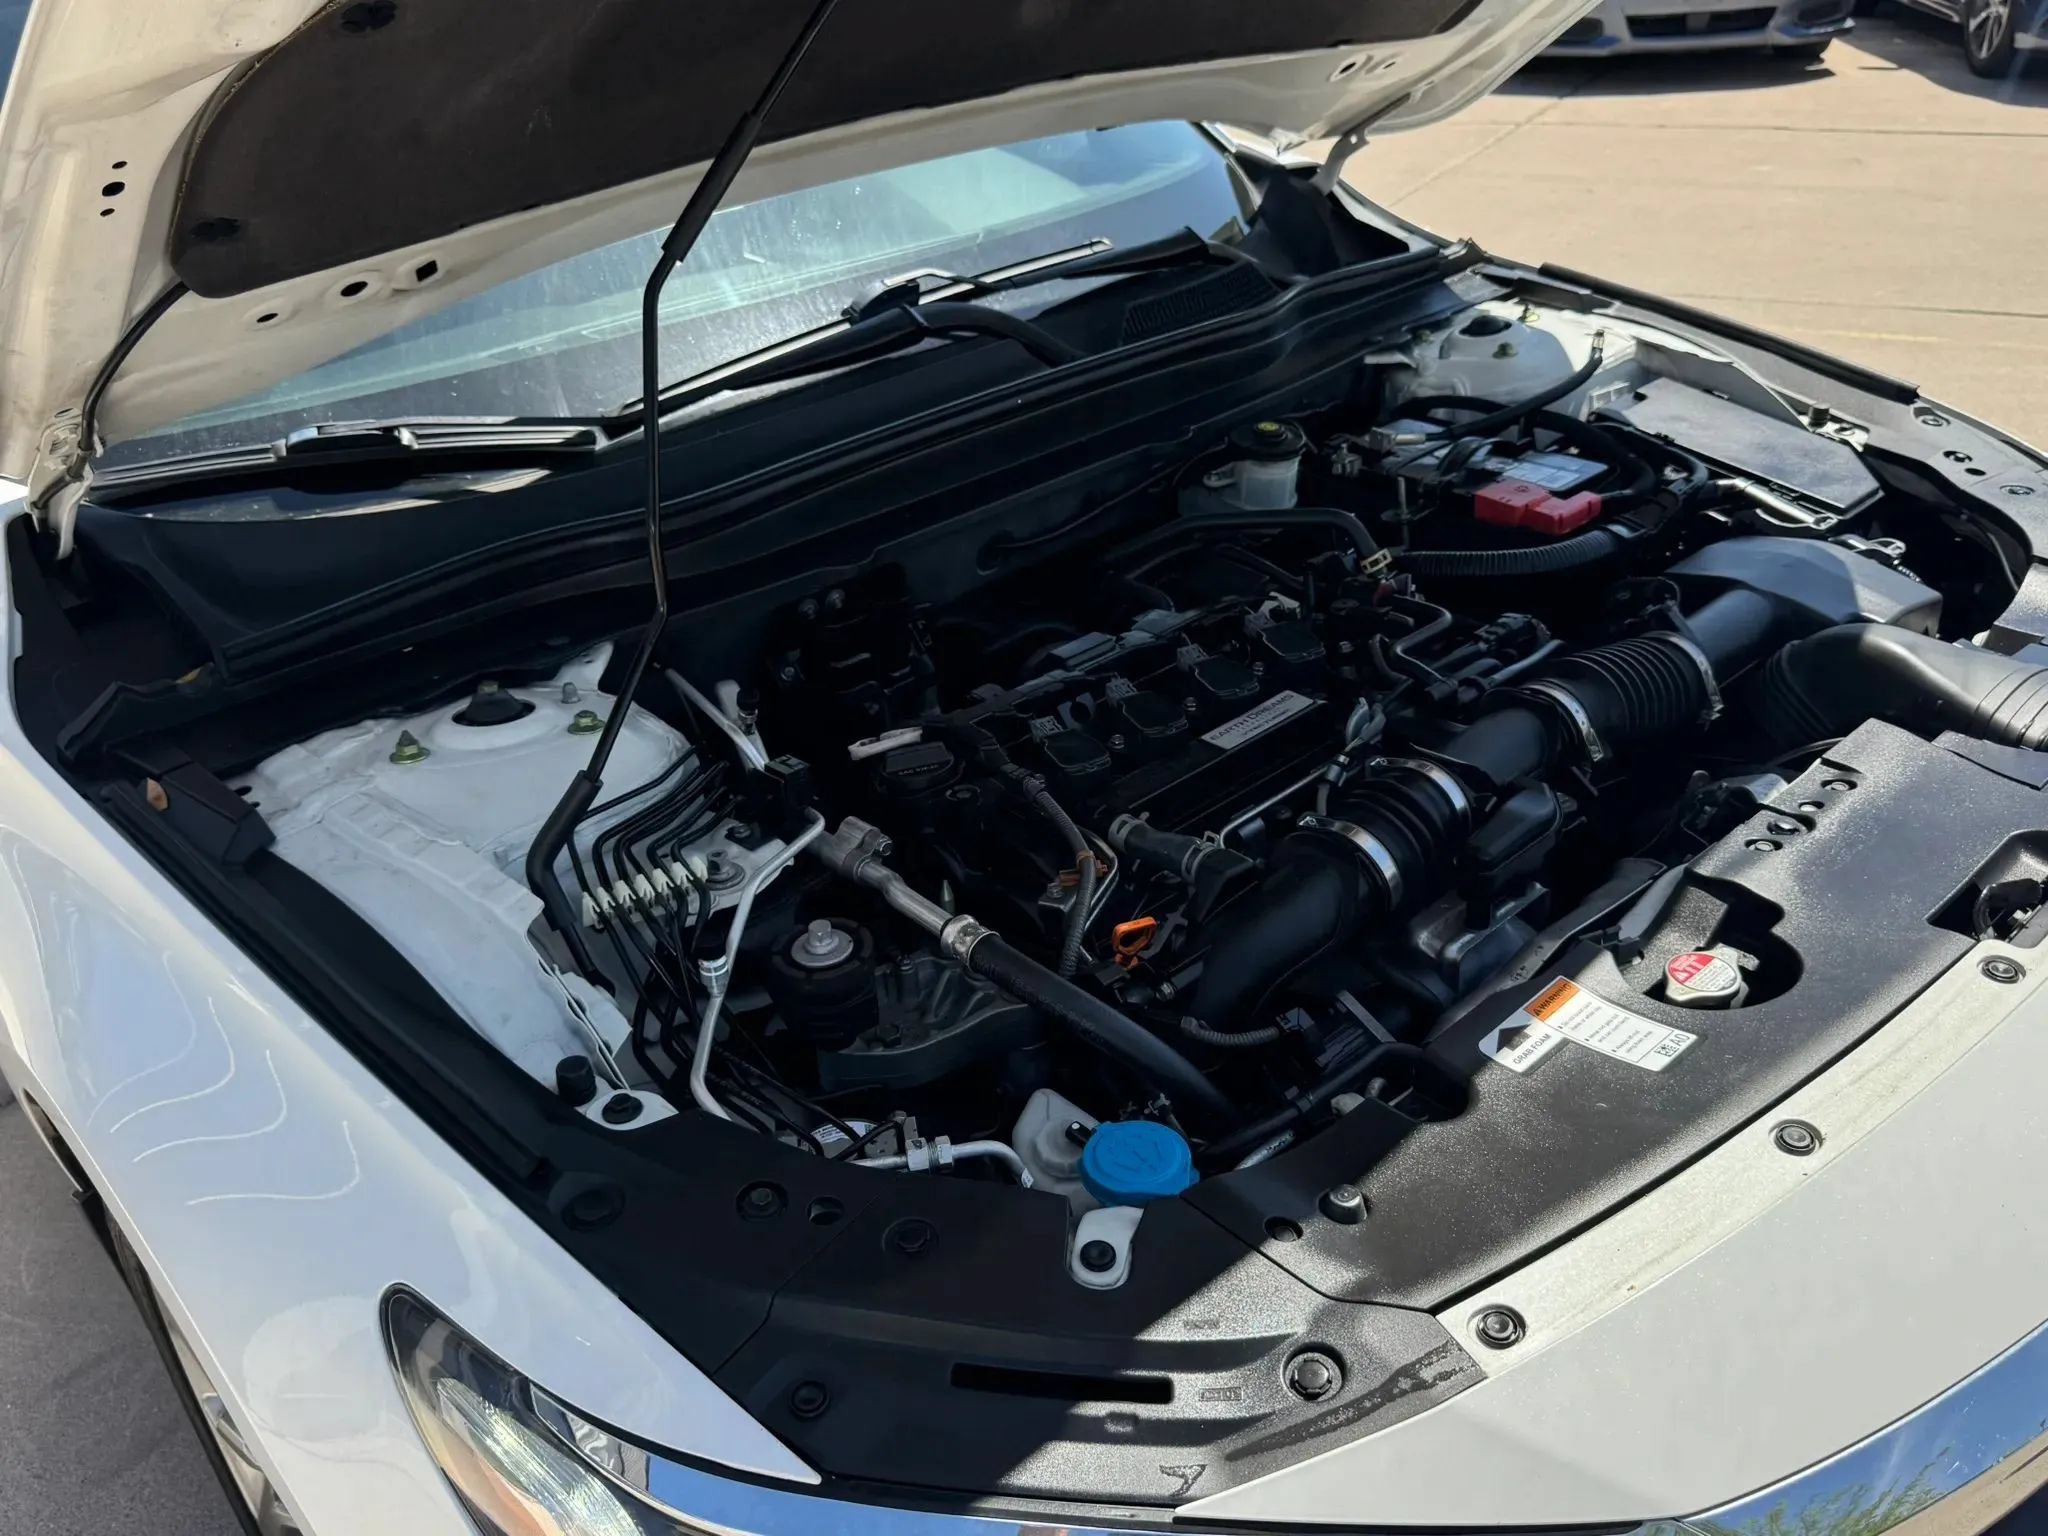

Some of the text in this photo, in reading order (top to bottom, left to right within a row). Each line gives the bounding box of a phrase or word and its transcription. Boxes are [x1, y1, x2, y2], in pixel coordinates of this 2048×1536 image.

[1210, 717, 1249, 741] EARTH
[1249, 694, 1294, 720] DREAMS
[1539, 982, 1573, 1014] WARNING
[1513, 1033, 1552, 1065] GRAB FOAM
